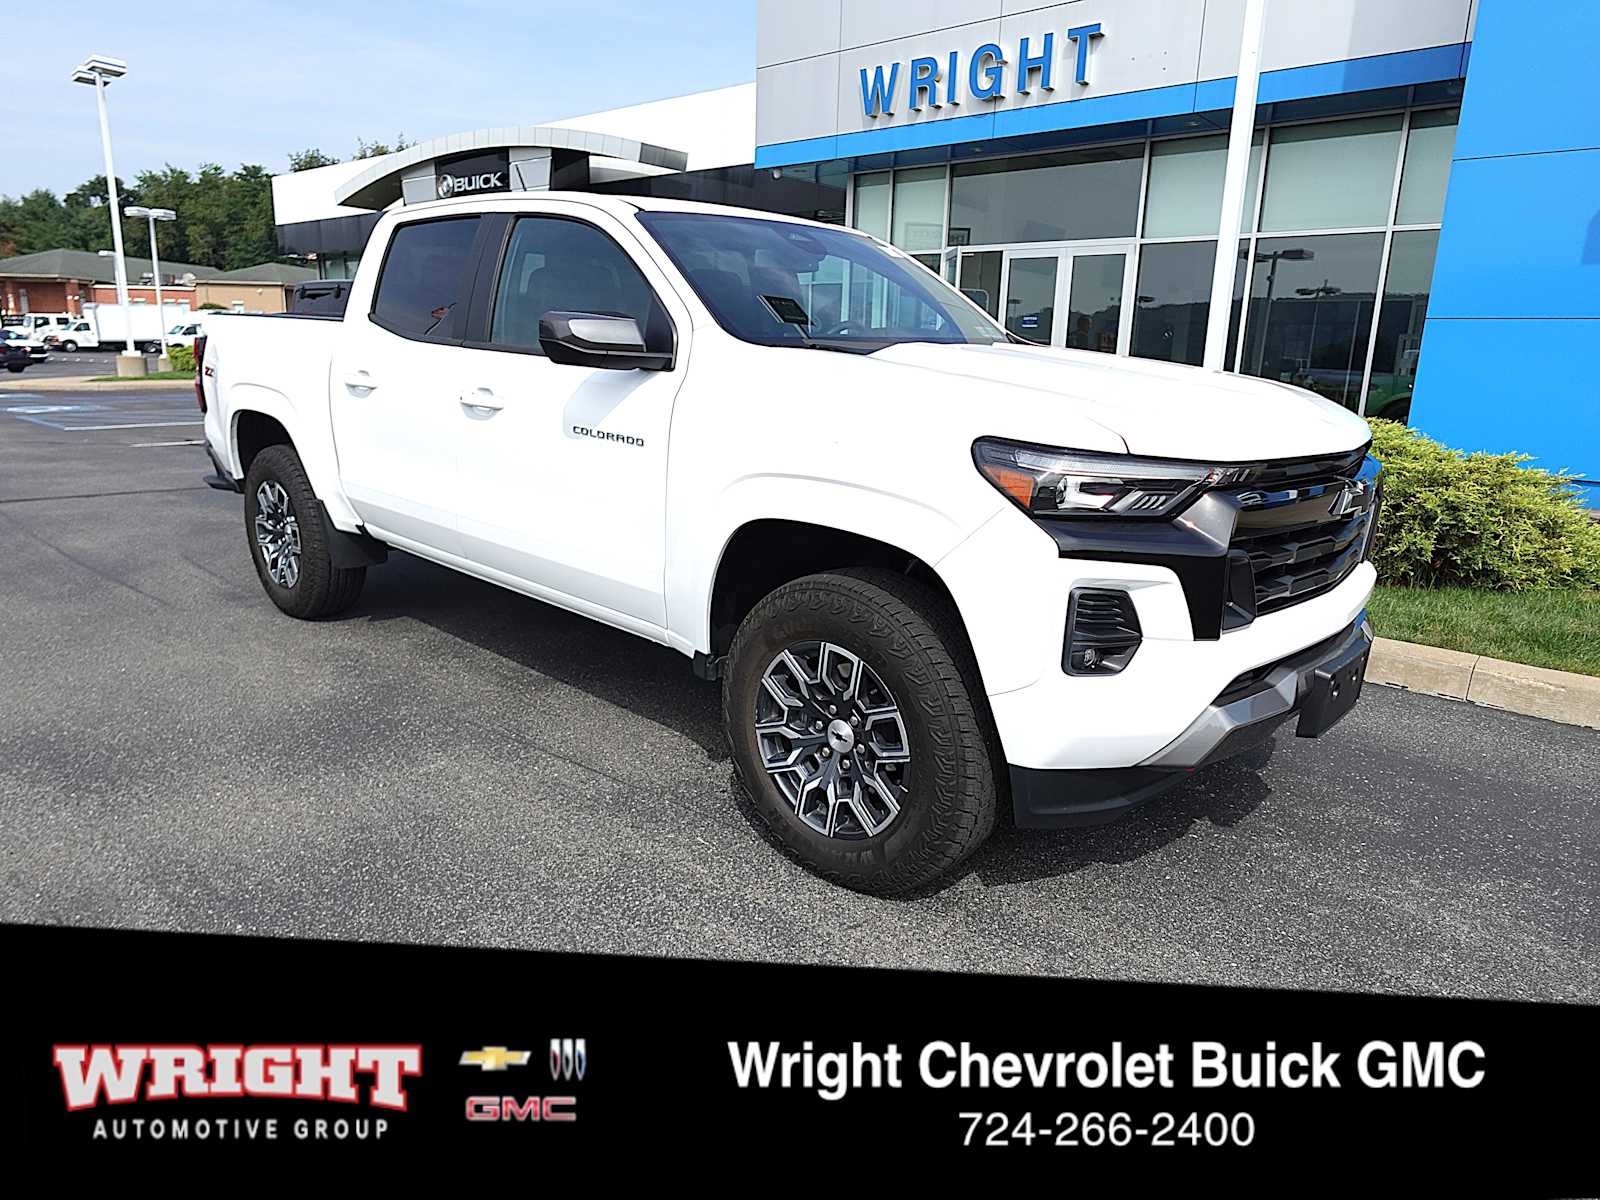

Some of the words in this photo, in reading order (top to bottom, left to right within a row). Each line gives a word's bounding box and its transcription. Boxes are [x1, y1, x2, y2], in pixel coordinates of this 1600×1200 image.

[860, 23, 1104, 117] WRIGHT
[453, 171, 503, 192] BUICK
[572, 426, 645, 447] COLORADO
